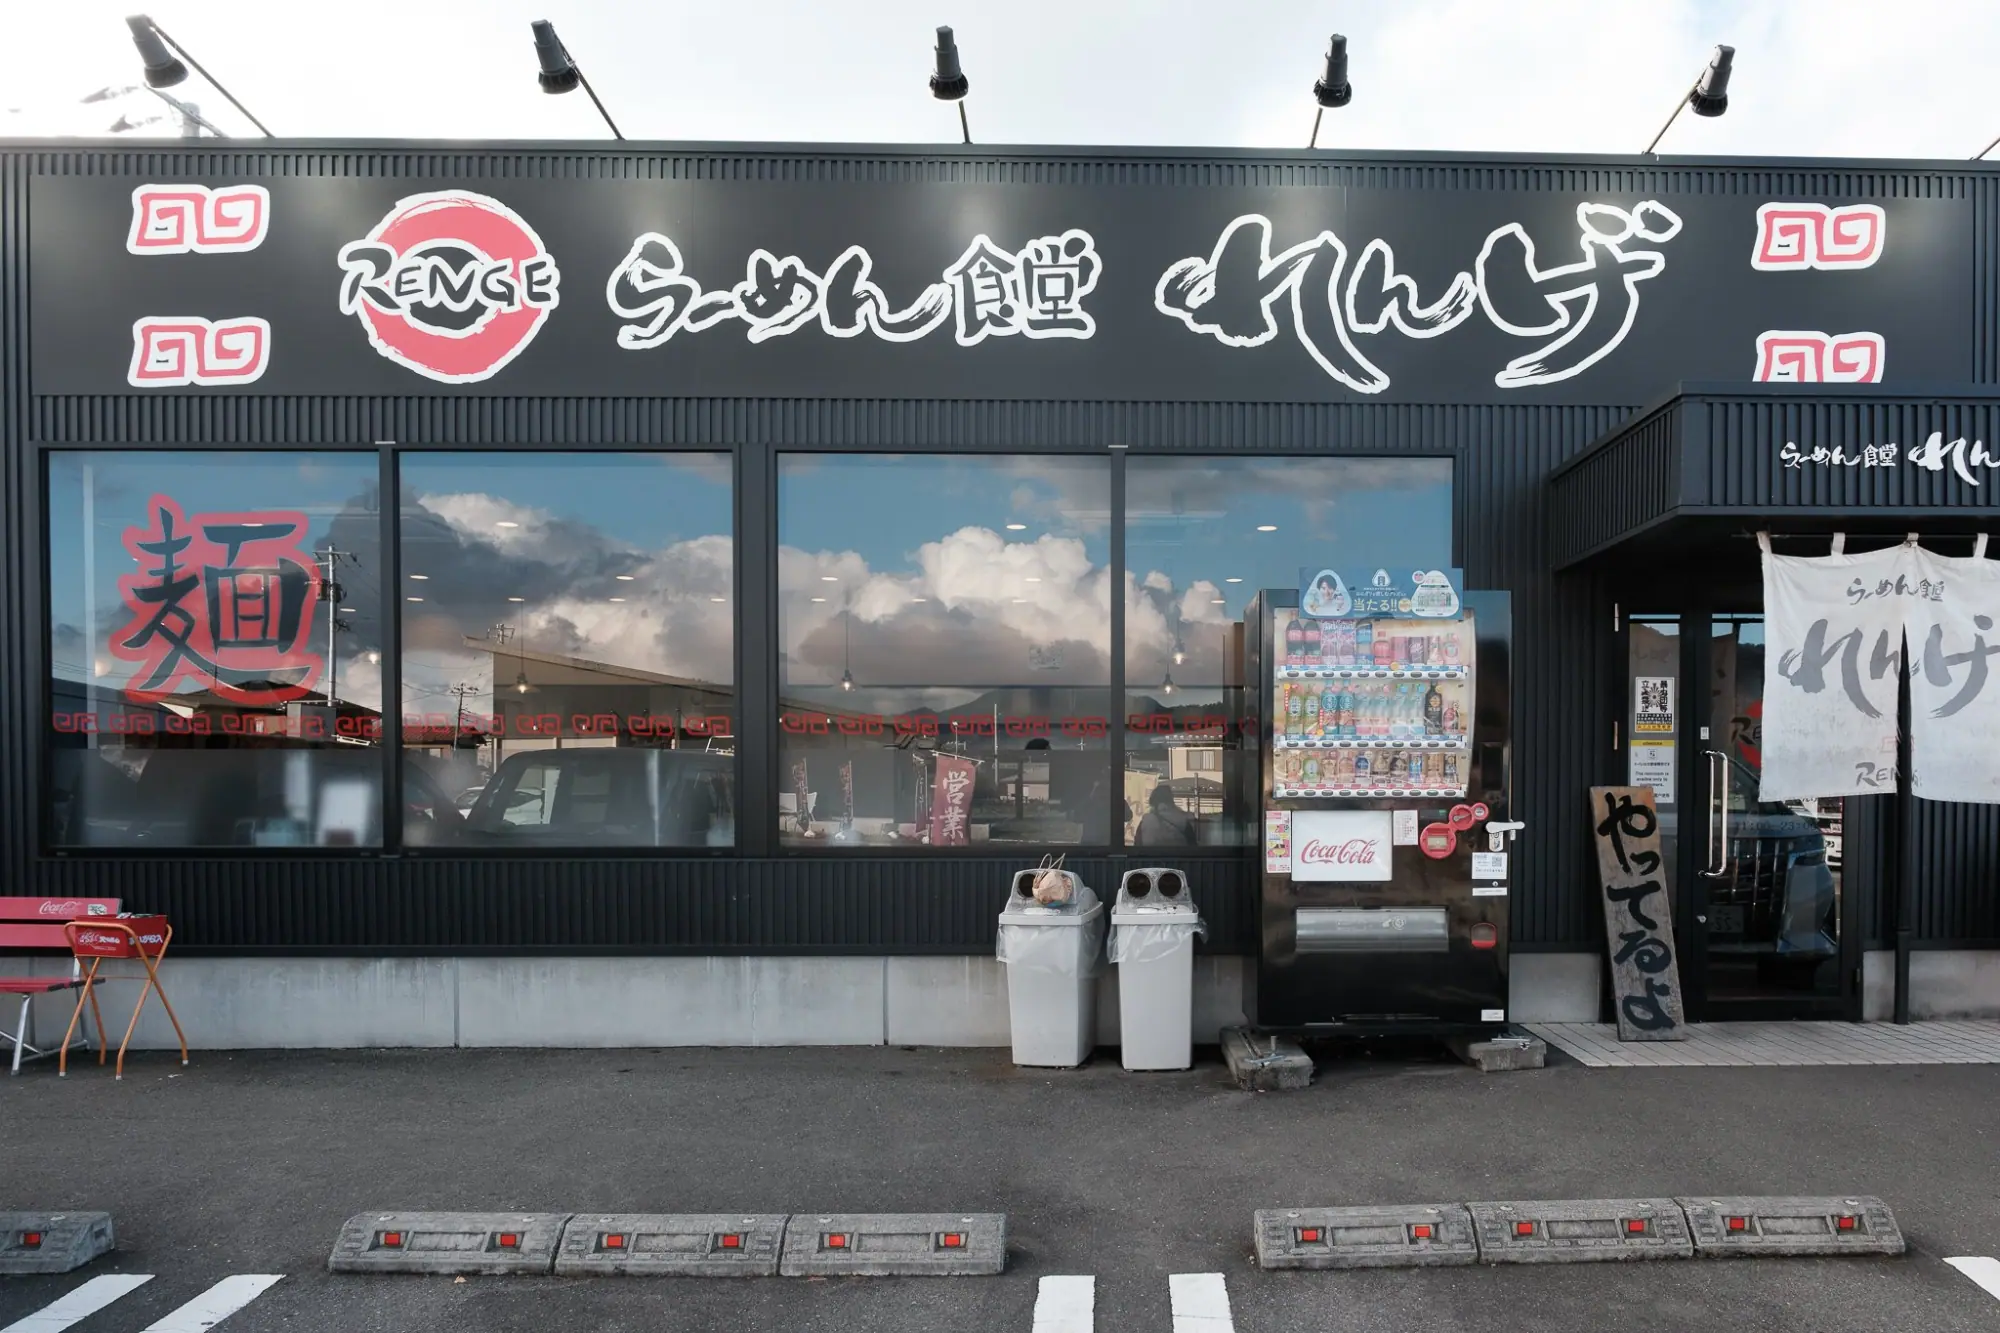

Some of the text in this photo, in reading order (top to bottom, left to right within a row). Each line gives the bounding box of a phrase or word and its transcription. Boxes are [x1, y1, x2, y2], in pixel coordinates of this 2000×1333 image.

[338, 238, 560, 315] RENGE
[606, 200, 1683, 393] らーめん食堂 れんげ
[1780, 441, 1898, 469] らーめん食堂
[1846, 573, 1945, 605] らーめん食堂
[1730, 716, 1763, 745] RE
[1301, 839, 1381, 864] Coca-Cola
[1597, 791, 1676, 1031] やってるよ
